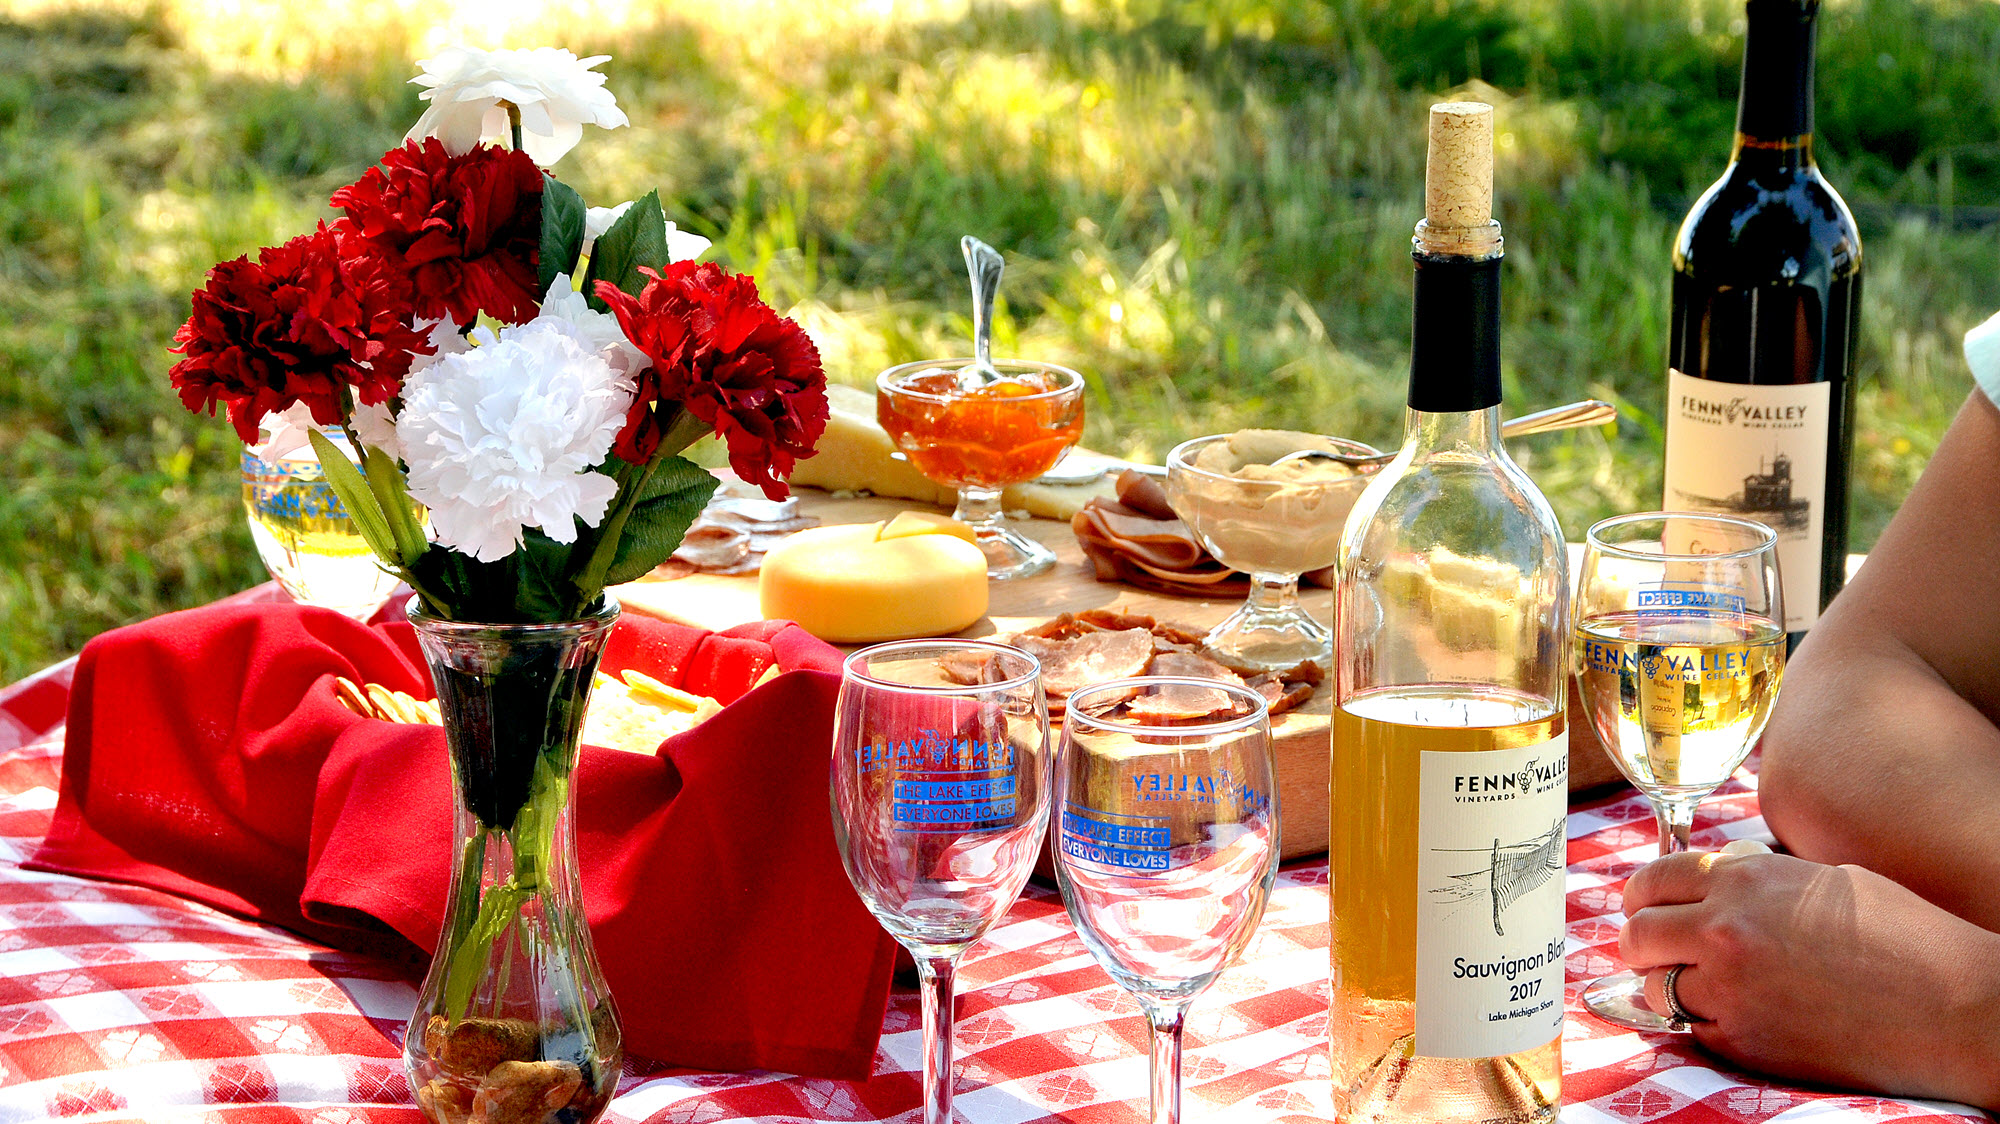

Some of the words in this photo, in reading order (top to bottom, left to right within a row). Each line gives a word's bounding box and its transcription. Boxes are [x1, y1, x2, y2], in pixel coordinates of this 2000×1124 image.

[1682, 395, 1722, 415] FENN
[1742, 405, 1807, 420] VALLEY
[1586, 641, 1637, 667] FENN
[1666, 650, 1750, 671] VALLEY
[1706, 670, 1746, 680] CELLAR
[1455, 773, 1516, 792] FENN
[1535, 753, 1568, 783] VALLE
[896, 783, 922, 799] THE
[929, 785, 964, 799] LAKE
[970, 779, 1013, 798] EFFECT
[1455, 793, 1516, 803] VINEYARDS
[1537, 783, 1554, 794] WINE
[896, 805, 972, 822] EVERYONE
[976, 804, 1013, 820] LOVES
[1083, 822, 1113, 840] LAKE
[1118, 828, 1167, 845] EFFECT
[1063, 837, 1120, 866] EVERYONE
[1123, 852, 1168, 868] LOVES
[1453, 954, 1544, 981] Sauvignon
[1547, 937, 1566, 963] Blan
[1509, 978, 1542, 1002] 2017
[1488, 1011, 1508, 1021] Lake
[1509, 1006, 1540, 1018] Michigan
